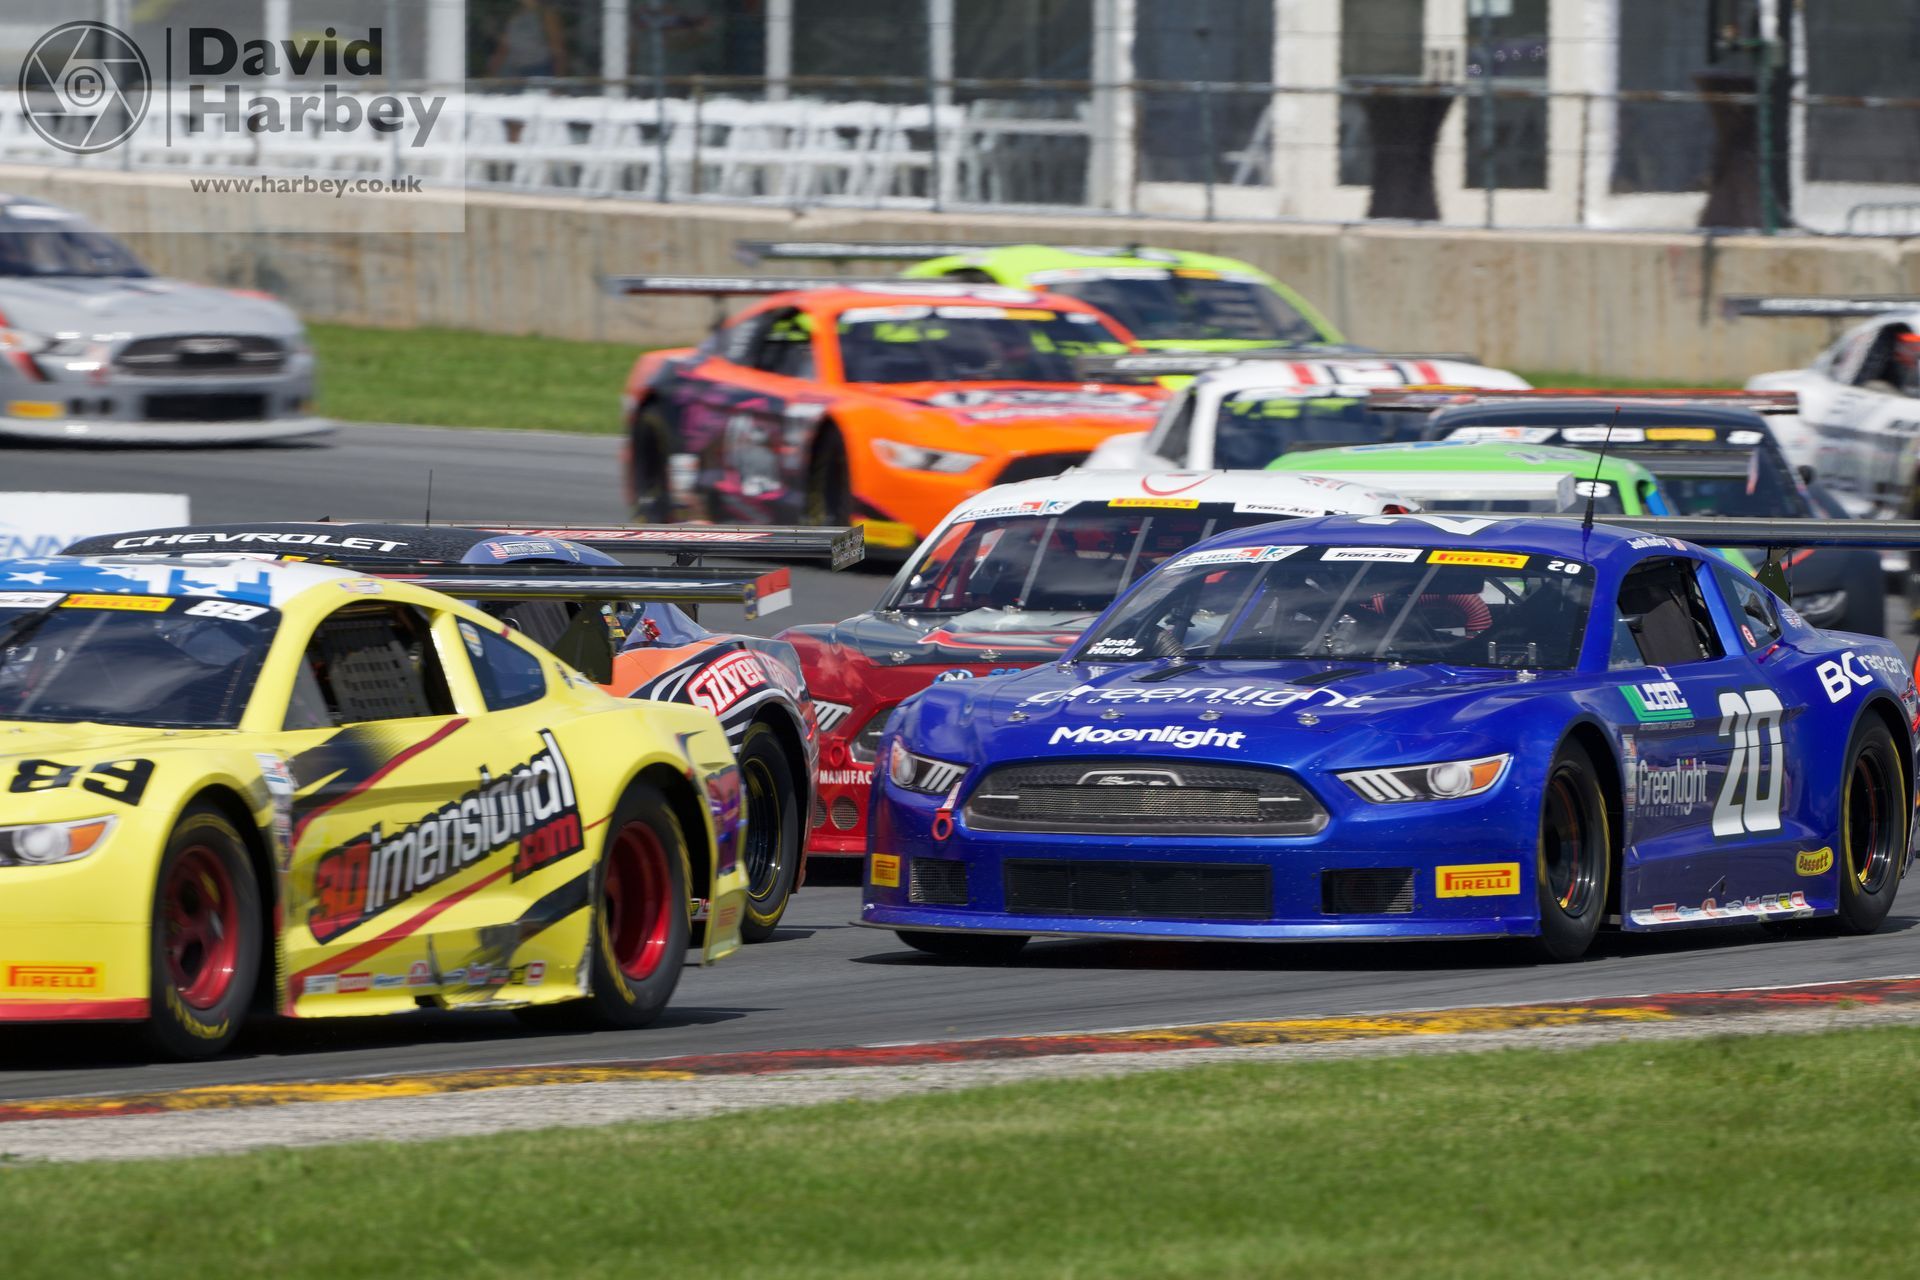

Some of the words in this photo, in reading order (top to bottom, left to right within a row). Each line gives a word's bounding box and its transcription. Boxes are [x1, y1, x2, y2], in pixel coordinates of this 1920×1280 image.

[113, 533, 407, 553] CHEVROLET
[1437, 553, 1519, 566] PIRELLI
[1548, 560, 1582, 574] 20
[68, 596, 163, 610] PIRELLI
[184, 600, 269, 621] 89
[1087, 646, 1143, 656] Hurley
[1096, 638, 1136, 646] Josh
[687, 650, 767, 716] Silver
[1816, 651, 1873, 704] BC
[1026, 685, 1376, 708] Greenlight
[1632, 681, 1688, 711] LOGIC
[1049, 726, 1247, 749] Moonlight
[1712, 689, 1784, 837] 20
[9, 759, 155, 806] 89
[1638, 758, 1707, 815] Greenlight
[1799, 851, 1829, 871] Bassett
[1444, 869, 1511, 891] PIRELLI
[8, 966, 96, 988] PIRELLI
